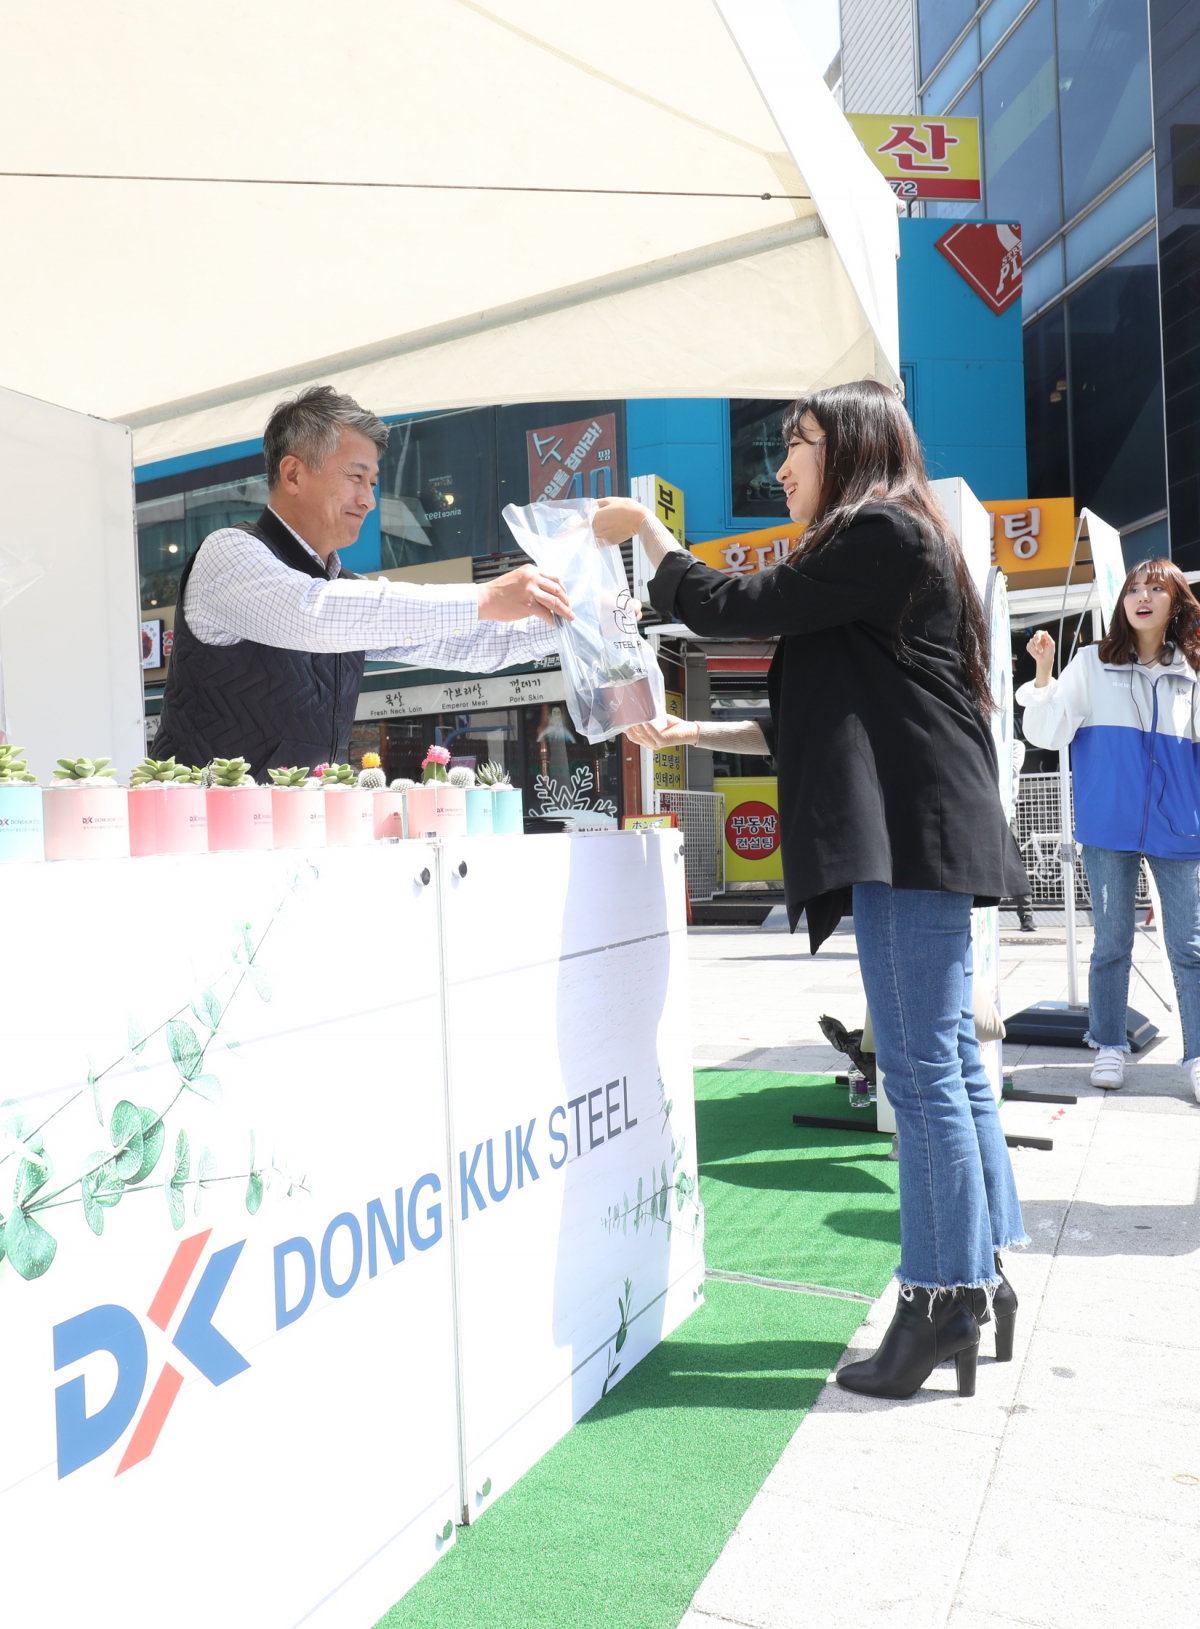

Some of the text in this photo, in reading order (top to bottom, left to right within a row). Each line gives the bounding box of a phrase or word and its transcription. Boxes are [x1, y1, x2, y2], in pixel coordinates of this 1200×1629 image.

[876, 123, 960, 173] 산
[996, 251, 1022, 296] PL
[992, 507, 1041, 560] 팅
[370, 705, 423, 717] Fresh Neck Loin
[442, 699, 489, 711] Emperor Meat
[509, 695, 525, 703] Pork
[731, 815, 777, 834] 부동산
[735, 837, 774, 850] 컨설팅
[548, 1075, 638, 1169] STEEL
[52, 1227, 252, 1481] DK
